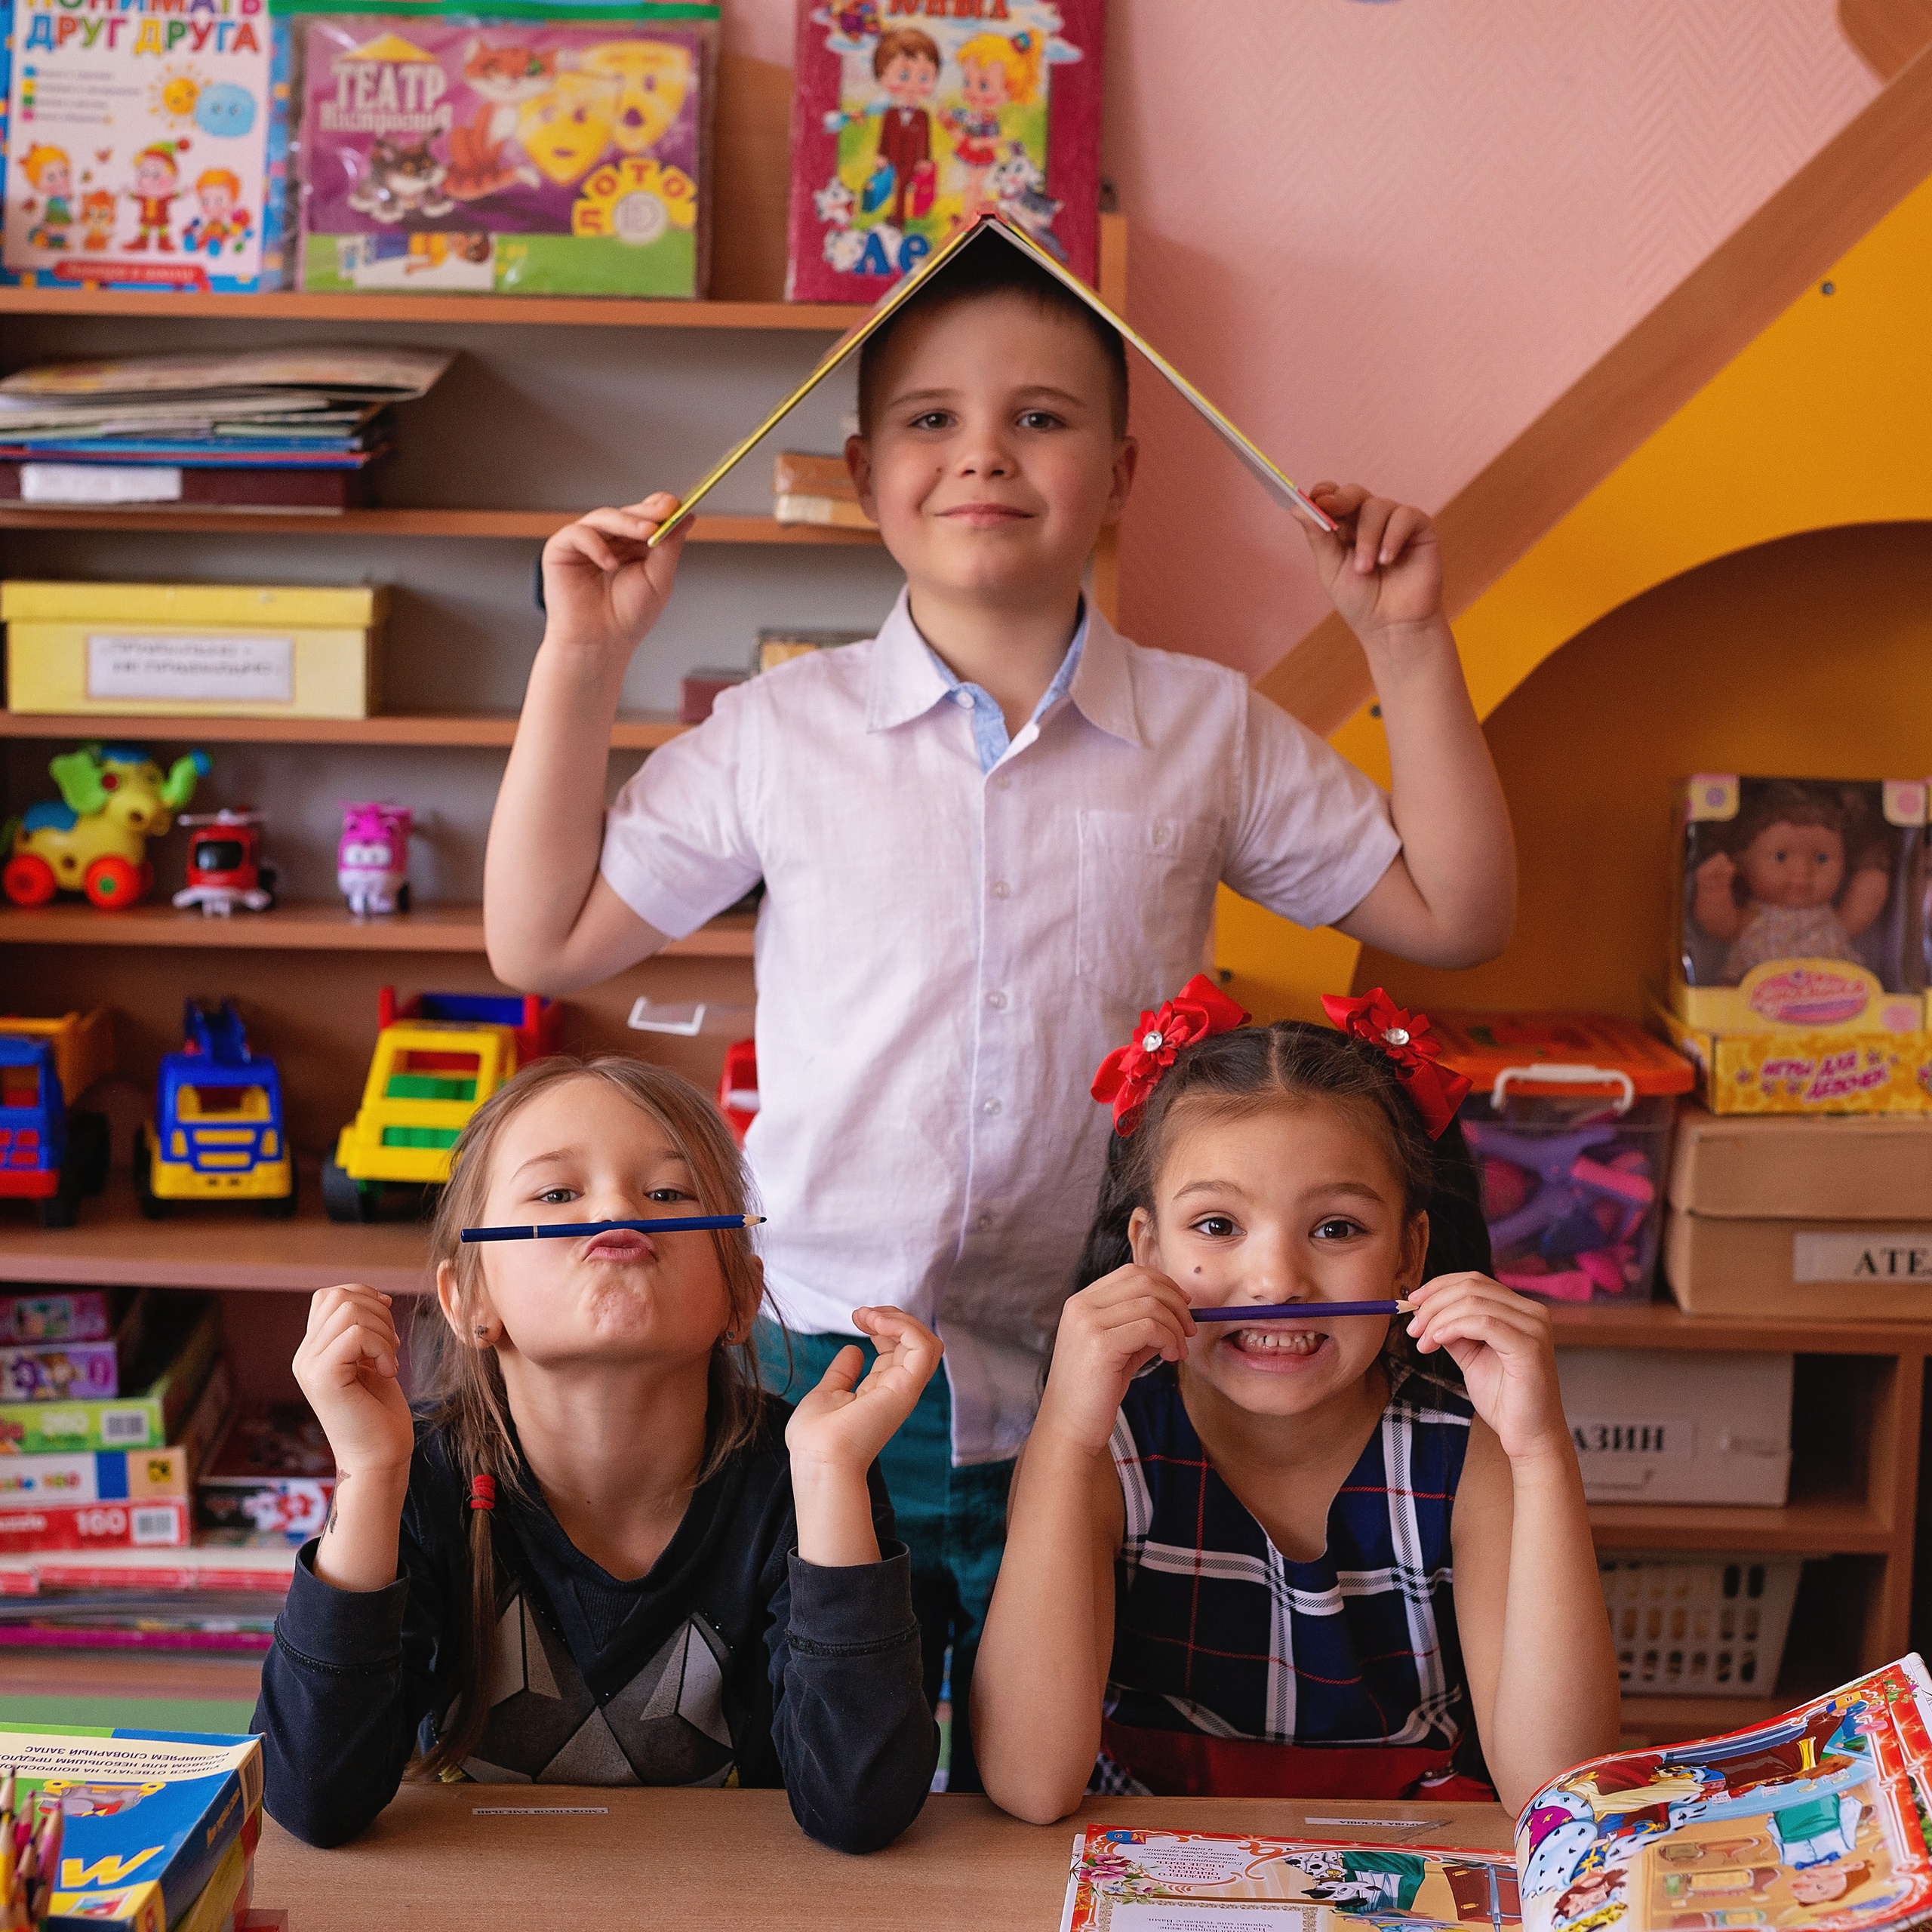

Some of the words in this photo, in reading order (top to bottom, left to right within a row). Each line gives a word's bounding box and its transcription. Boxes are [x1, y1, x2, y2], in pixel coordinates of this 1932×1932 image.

[26, 14, 127, 51] ДРУГ
[134, 18, 259, 55] ДРУГА
[329, 61, 448, 112] ТЕАТР
[1854, 1247, 1932, 1277] АТЕ
[25, 1746, 66, 1755] ЗАПАС
[69, 1749, 148, 1759] СЛОВАРНЫЙ
[0, 1755, 52, 1763] ПРЕДЛО
[152, 1752, 229, 1761] РАСШИРЯЕМ
[56, 1758, 137, 1767] НЕБОЛЬШИМ
[171, 1758, 225, 1768] СЛОВОМ
[170, 1764, 219, 1775] УЧИМСЯ
[1158, 1872, 1220, 1880] БЛИЖНЕГО
